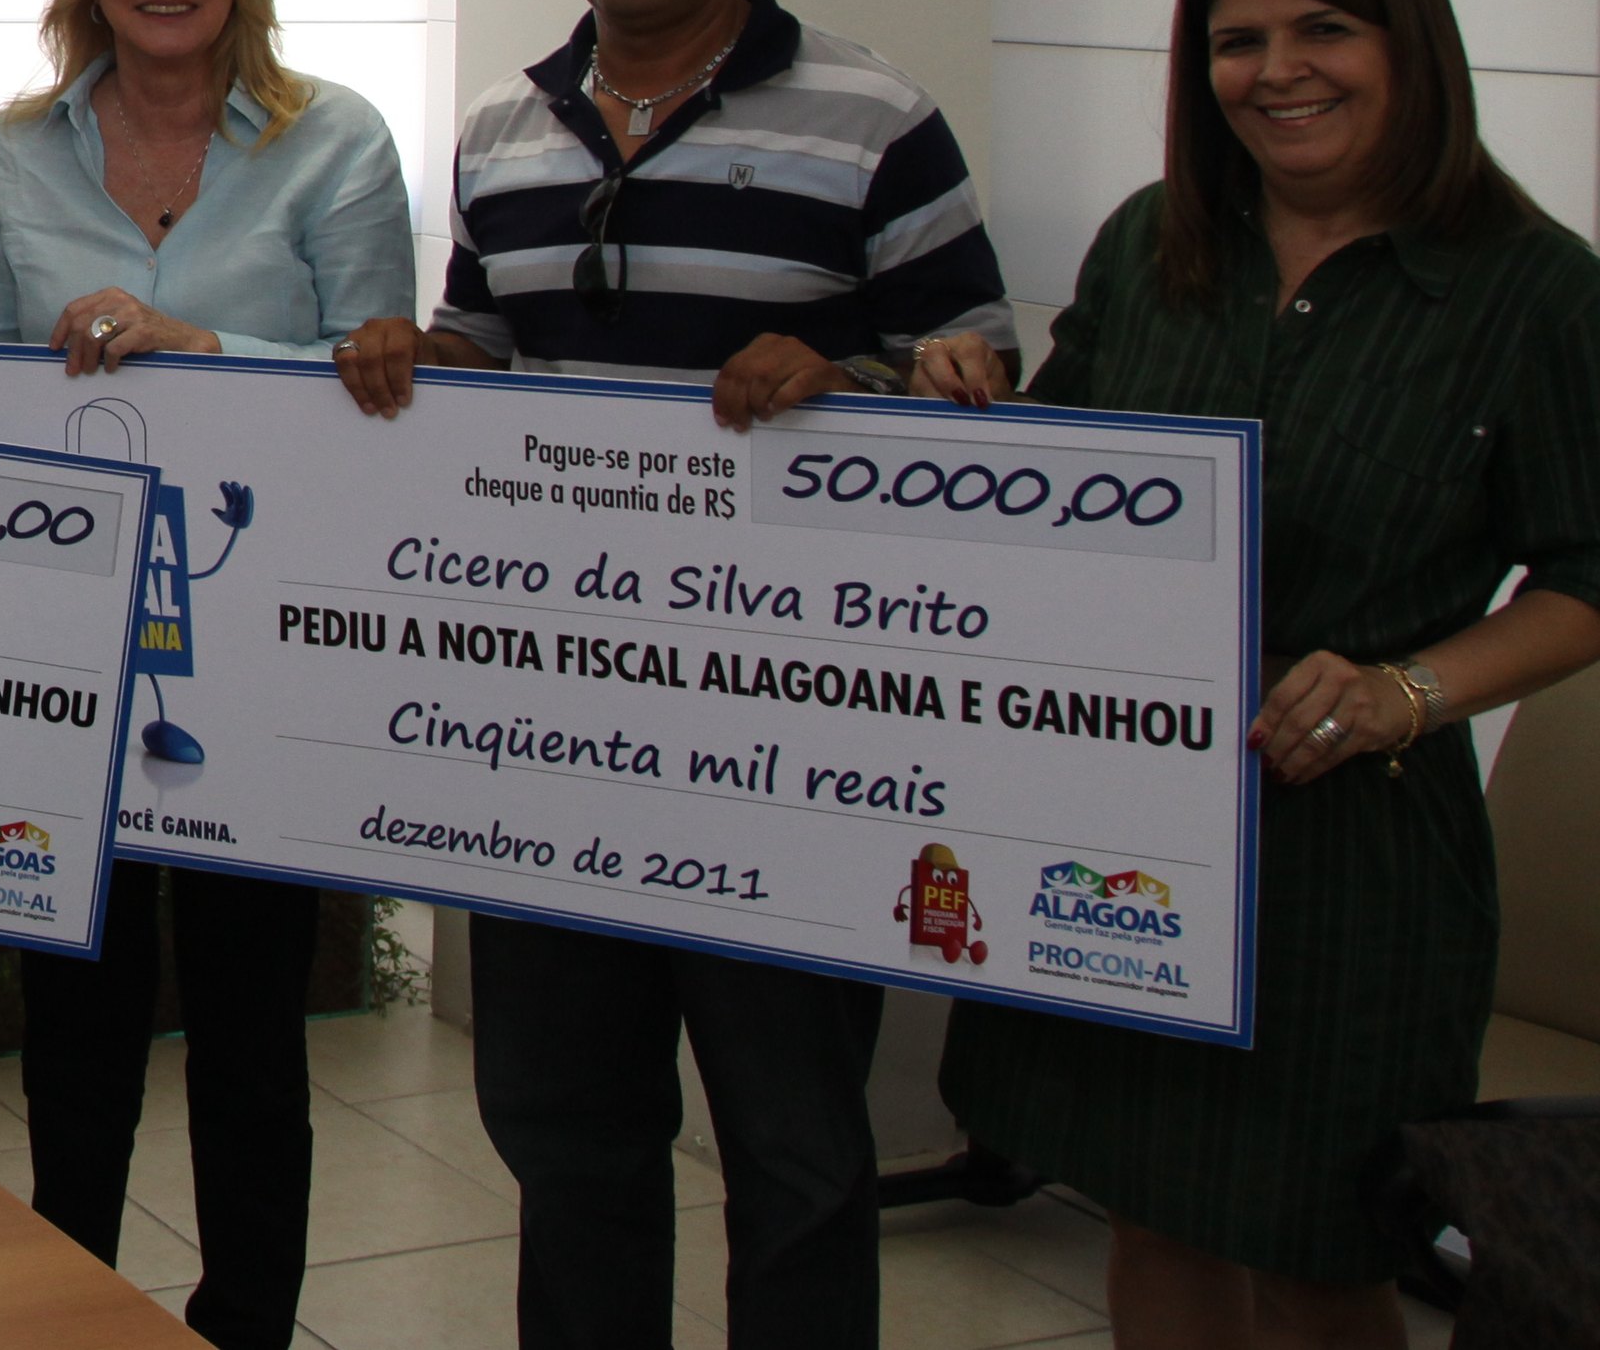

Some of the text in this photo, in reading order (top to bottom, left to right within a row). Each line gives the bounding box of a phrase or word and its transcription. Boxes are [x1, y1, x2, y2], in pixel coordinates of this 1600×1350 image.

[733, 167, 747, 184] M
[525, 434, 736, 479] Pague-se por este
[465, 468, 736, 521] cheque a quantia de R$
[782, 454, 1183, 528] 50.000,00
[387, 537, 989, 639] Cicero da Silva Brito
[279, 604, 1213, 751] PEDIU A NOTA FISCAL ALAGOANA E GANHOU
[388, 701, 946, 817] Cinqüenta mil reais
[118, 808, 237, 844] OCÊ GANHA.
[0, 869, 16, 877] pela
[18, 872, 39, 881] gente
[359, 804, 769, 901] dezembro de 2011
[925, 886, 965, 910] PEF
[1029, 893, 1181, 938] ALAGOAS
[1044, 920, 1162, 946] Gente que faz pela gente
[1028, 941, 1189, 988] PROCON-AL
[1029, 965, 1081, 981] Defendendo
[1091, 977, 1143, 991] consumidor
[1146, 986, 1188, 998] alagoano
